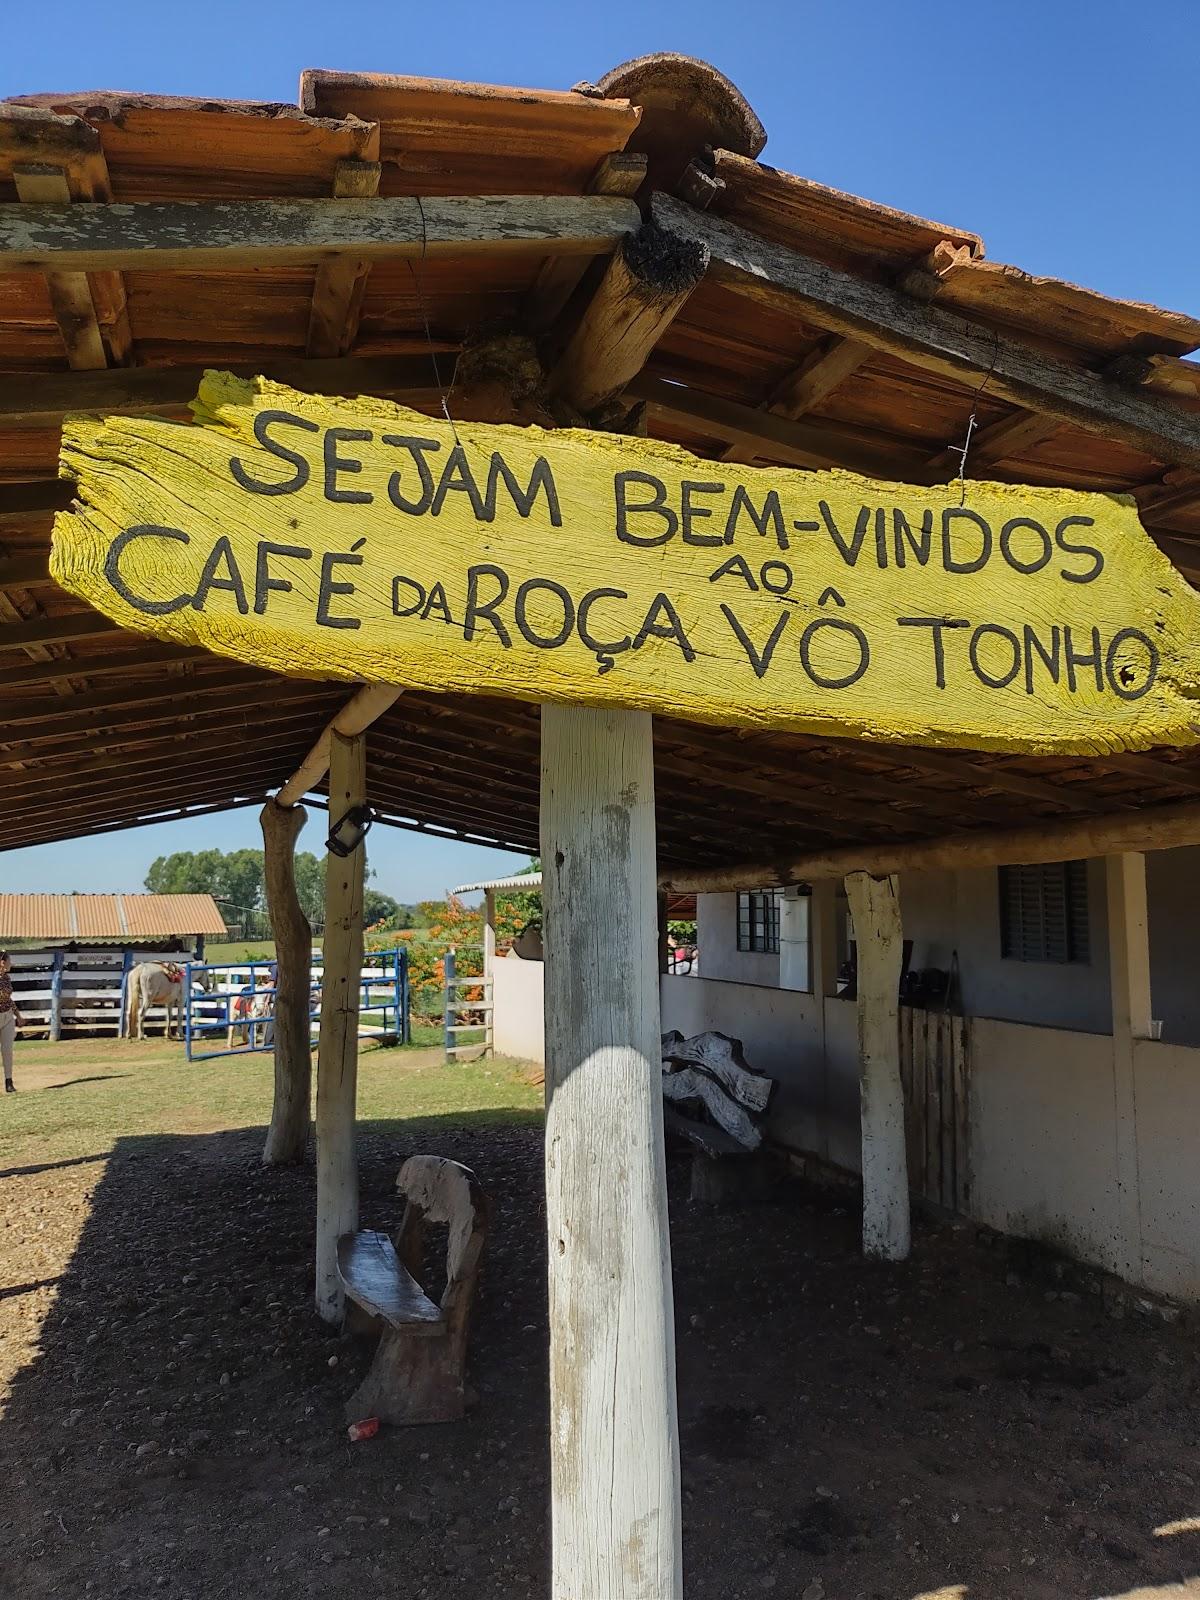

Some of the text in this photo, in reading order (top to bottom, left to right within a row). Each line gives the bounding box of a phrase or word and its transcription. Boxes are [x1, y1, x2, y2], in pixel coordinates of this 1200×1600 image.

[229, 410, 1105, 583] SEJAM BEM-VINDOS
[709, 555, 793, 594] AO
[104, 524, 1160, 700] CAFÉ DA ROÇA VÔ TONHO
